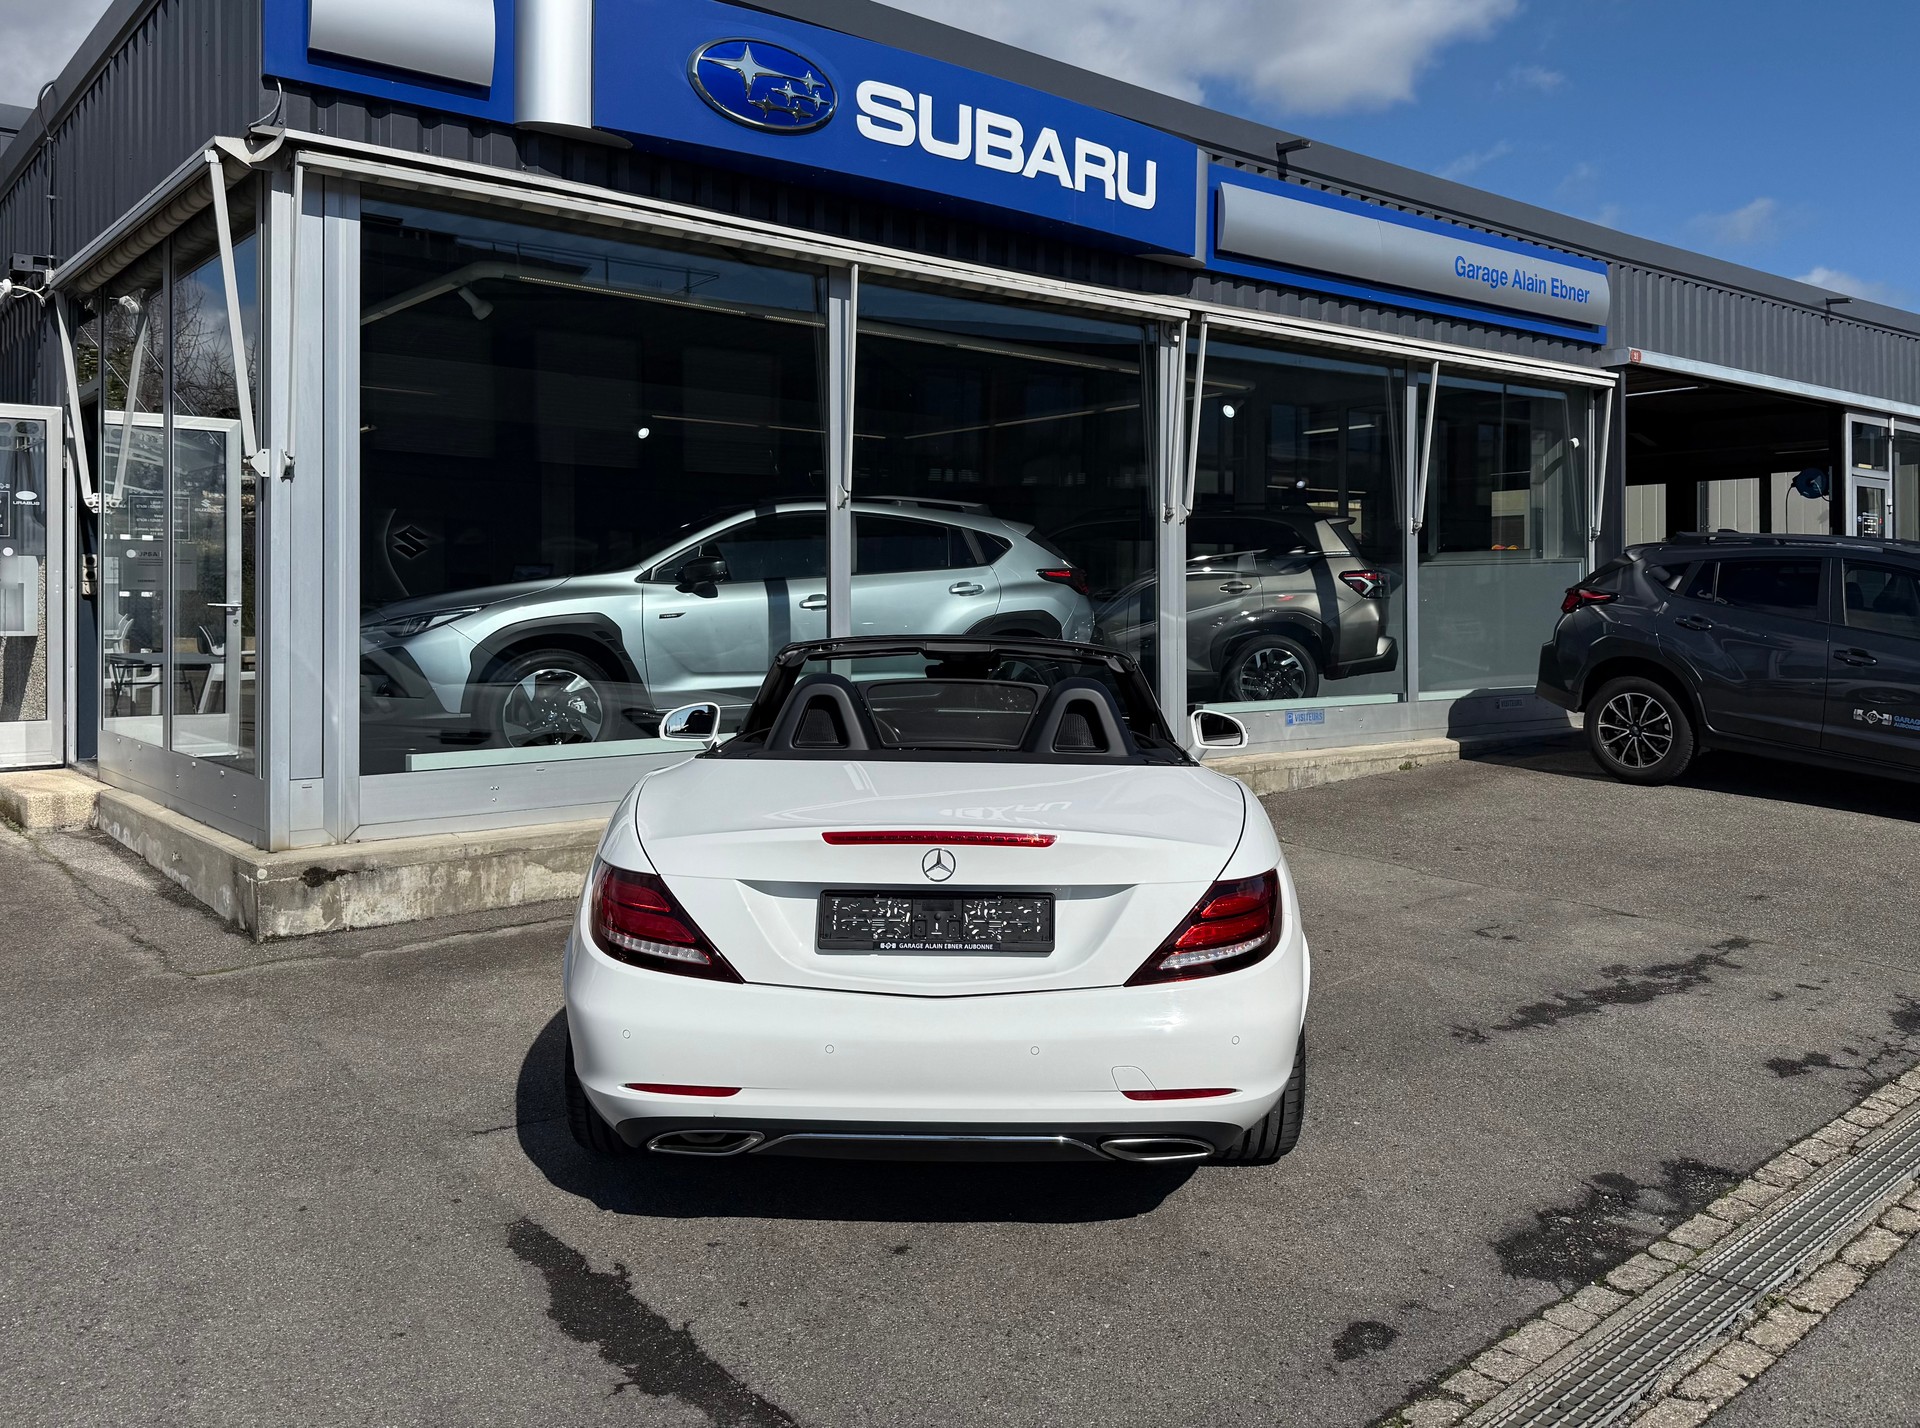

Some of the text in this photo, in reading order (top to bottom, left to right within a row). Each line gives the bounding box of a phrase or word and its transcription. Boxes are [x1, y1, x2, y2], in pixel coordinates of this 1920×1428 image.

[856, 80, 1157, 210] SUBARU
[1454, 255, 1590, 303] Garage Alain Ebner
[1295, 711, 1323, 722] VISITEURS
